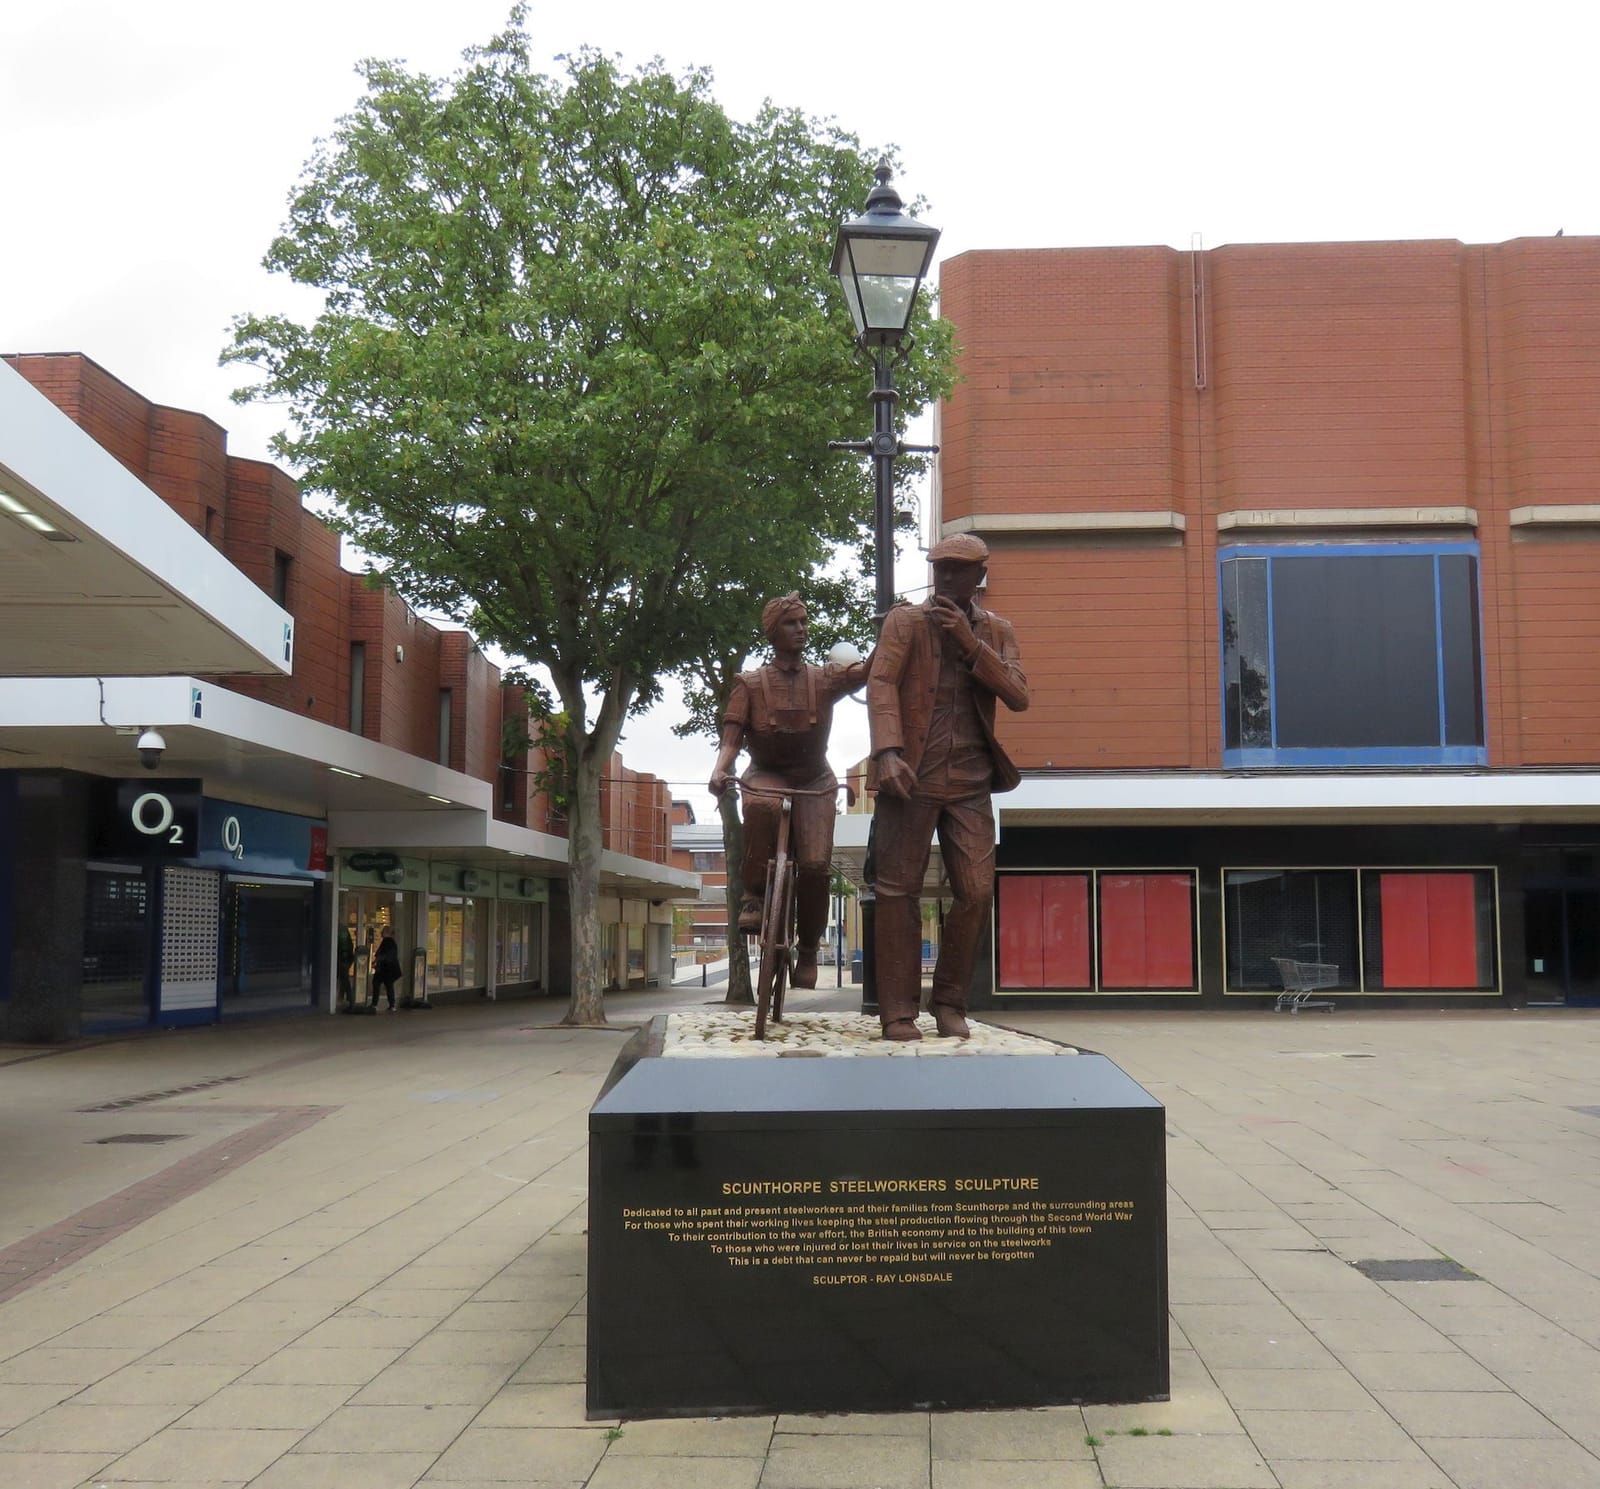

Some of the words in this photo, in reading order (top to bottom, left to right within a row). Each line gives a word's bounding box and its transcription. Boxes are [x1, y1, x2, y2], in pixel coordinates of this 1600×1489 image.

[722, 1182, 822, 1194] SCUNTHORPE
[829, 1180, 947, 1193] STEELWORKERS
[954, 1179, 1039, 1191] SCULPTURE
[623, 1207, 672, 1217] Dedicated
[674, 1207, 684, 1216] to
[686, 1207, 698, 1216] all
[700, 1206, 722, 1218] past
[724, 1206, 742, 1215] and
[744, 1206, 781, 1217] present
[783, 1204, 845, 1214] steelworkers
[847, 1204, 865, 1213] and
[867, 1203, 890, 1213] their
[891, 1203, 929, 1212] families
[930, 1202, 953, 1212] from
[955, 1201, 1010, 1213] Scunthorpe
[1012, 1201, 1030, 1210] and
[1032, 1201, 1047, 1210] the
[1049, 1200, 1107, 1212] surrounding
[1109, 1201, 1134, 1209] areas
[624, 1220, 642, 1230] For
[643, 1220, 671, 1229] those
[673, 1219, 694, 1229] who
[696, 1220, 724, 1230] spent
[726, 1218, 749, 1228] their
[750, 1218, 790, 1229] working
[792, 1217, 814, 1227] lives
[816, 1216, 855, 1228] keeping
[857, 1216, 872, 1225] the
[874, 1216, 898, 1225] steel
[900, 1215, 952, 1227] production
[954, 1214, 989, 1226] flowing
[990, 1213, 1028, 1225] through
[1030, 1213, 1046, 1222] the
[1048, 1212, 1083, 1222] Second
[1084, 1212, 1113, 1221] World
[1114, 1211, 1133, 1221] War
[668, 1232, 680, 1241] To
[682, 1231, 705, 1241] their
[707, 1230, 766, 1240] contribution
[768, 1230, 779, 1239] to
[781, 1230, 797, 1239] the
[798, 1231, 817, 1239] war
[850, 1228, 865, 1238] the
[866, 1228, 899, 1237] British
[901, 1229, 945, 1239] economy
[947, 1226, 965, 1236] and
[967, 1226, 977, 1235] to
[979, 1226, 994, 1235] the
[996, 1225, 1035, 1237] building
[1037, 1225, 1048, 1234] of
[1049, 1224, 1067, 1234] this
[1069, 1224, 1092, 1233] town
[710, 1244, 723, 1253] To
[725, 1243, 753, 1253] those
[754, 1243, 775, 1252] who
[777, 1244, 801, 1252] were
[803, 1241, 837, 1253] injured
[851, 1241, 870, 1250] lost
[872, 1240, 894, 1250] their
[896, 1240, 918, 1249] lives
[921, 1240, 930, 1249] in
[932, 1239, 967, 1248] service
[969, 1240, 981, 1248] on
[983, 1238, 999, 1247] the
[1000, 1237, 1052, 1247] steelworks
[728, 1256, 750, 1265] This
[752, 1255, 761, 1265] is
[772, 1255, 794, 1264] debt
[795, 1254, 814, 1264] that
[836, 1255, 864, 1263] never
[865, 1253, 878, 1262] be
[880, 1252, 910, 1264] repaid
[912, 1252, 928, 1261] but
[930, 1251, 946, 1261] will
[977, 1250, 989, 1260] be
[991, 1249, 1035, 1261] forgotten
[813, 1274, 868, 1285] SCULPTOR
[876, 1273, 896, 1283] RAY
[898, 1272, 953, 1283] LONSDALE
